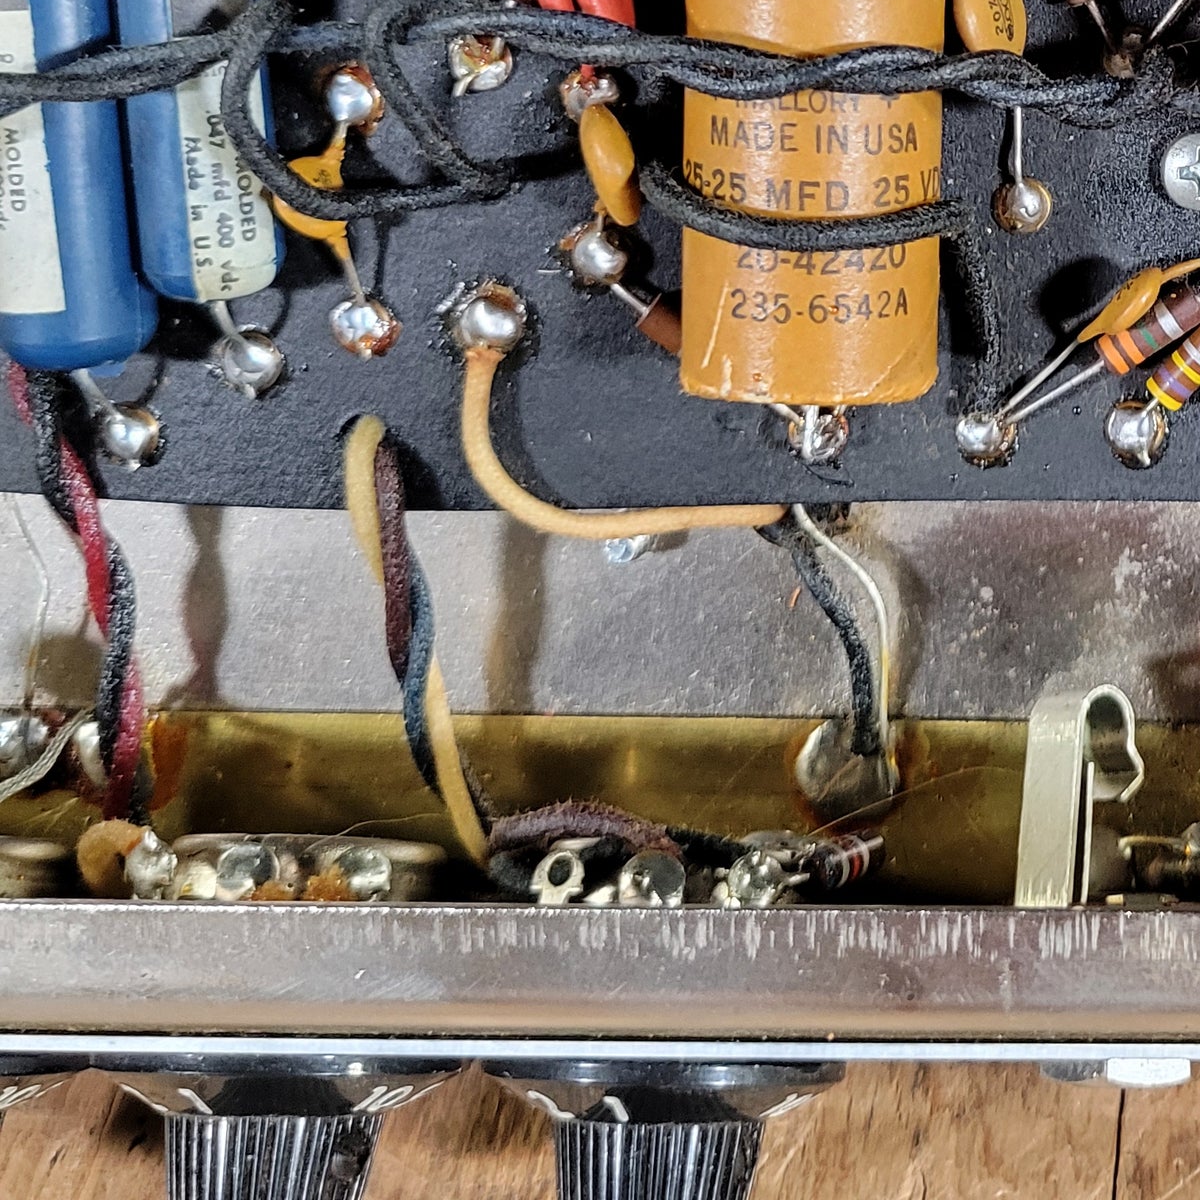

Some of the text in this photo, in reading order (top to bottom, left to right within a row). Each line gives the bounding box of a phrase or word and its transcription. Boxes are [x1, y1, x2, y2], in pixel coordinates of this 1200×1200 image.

[710, 115, 918, 156] MADE IN USA
[3, 127, 27, 212] MOLDED
[765, 178, 850, 212] MFD
[872, 174, 910, 208] 25
[216, 212, 235, 249] 400
[731, 288, 908, 324] 235-6542A
